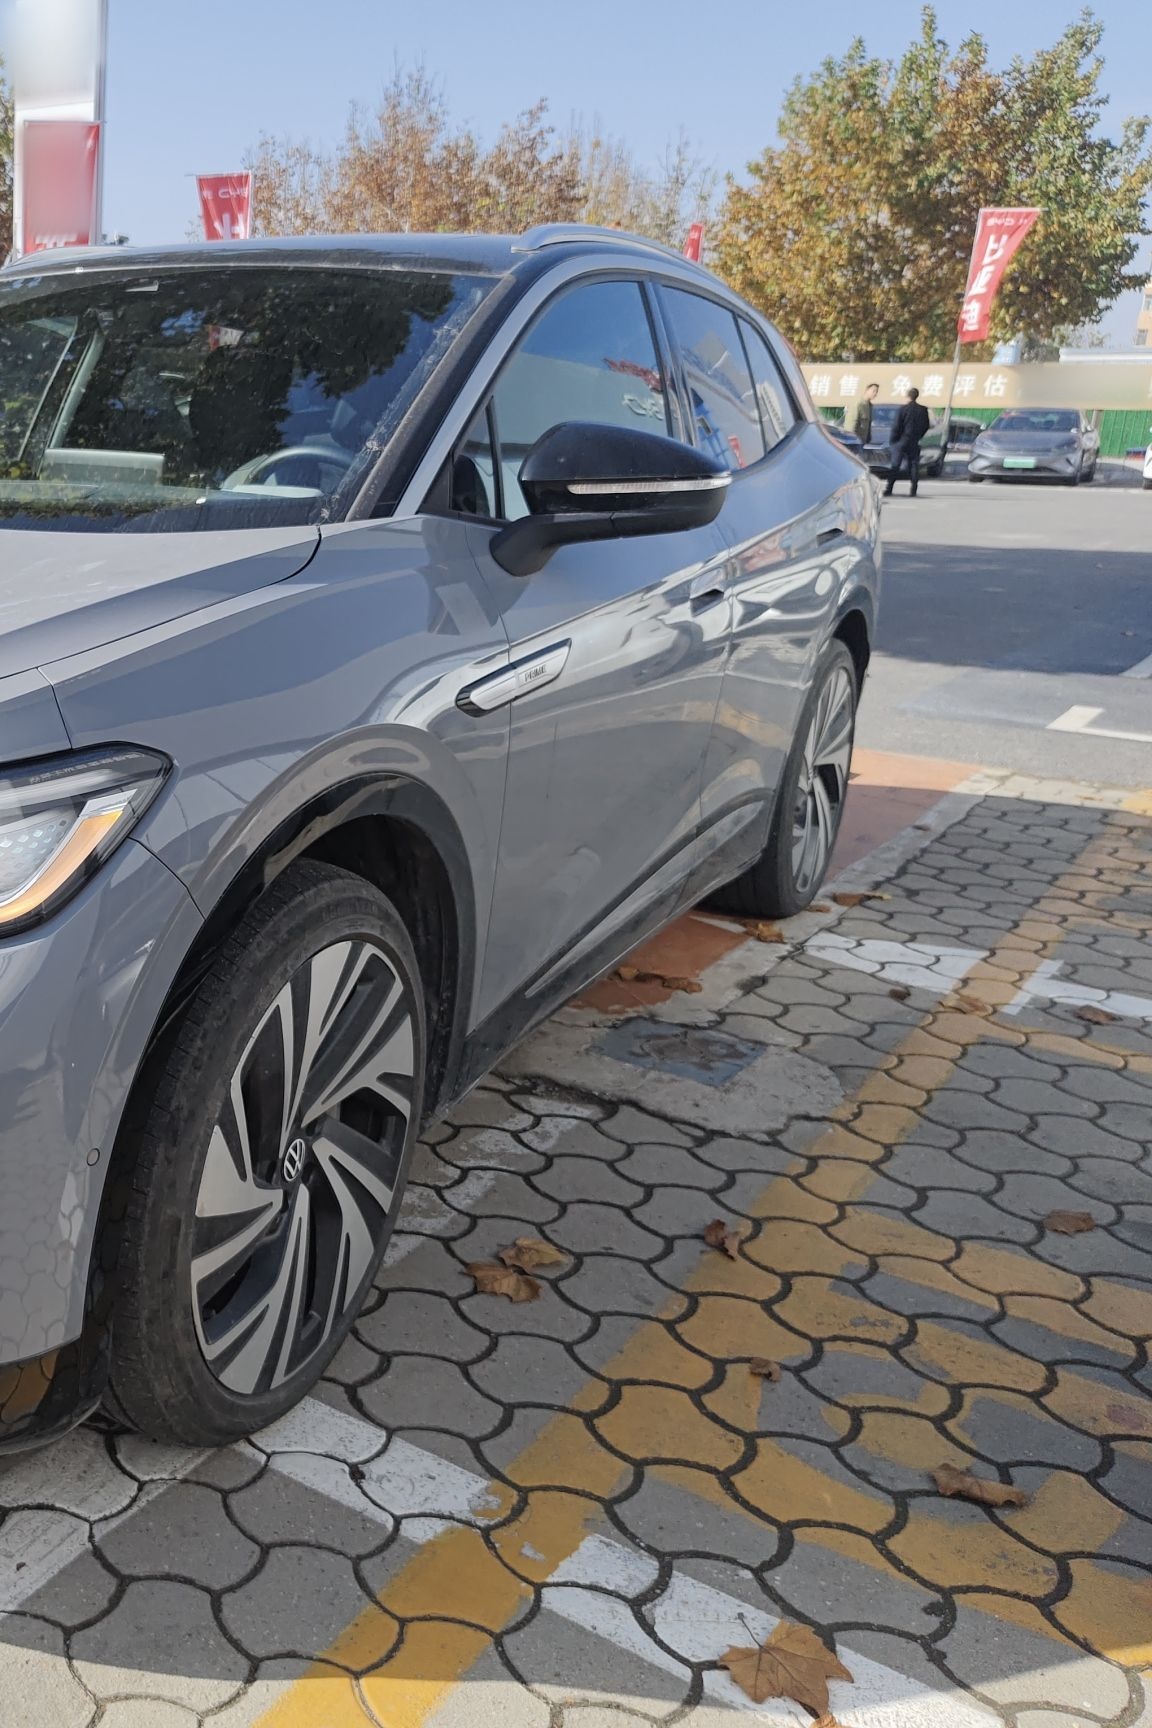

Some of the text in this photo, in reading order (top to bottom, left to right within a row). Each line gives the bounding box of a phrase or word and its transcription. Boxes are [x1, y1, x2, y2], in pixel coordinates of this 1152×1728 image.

[809, 373, 1008, 398] 销售 免费评估
